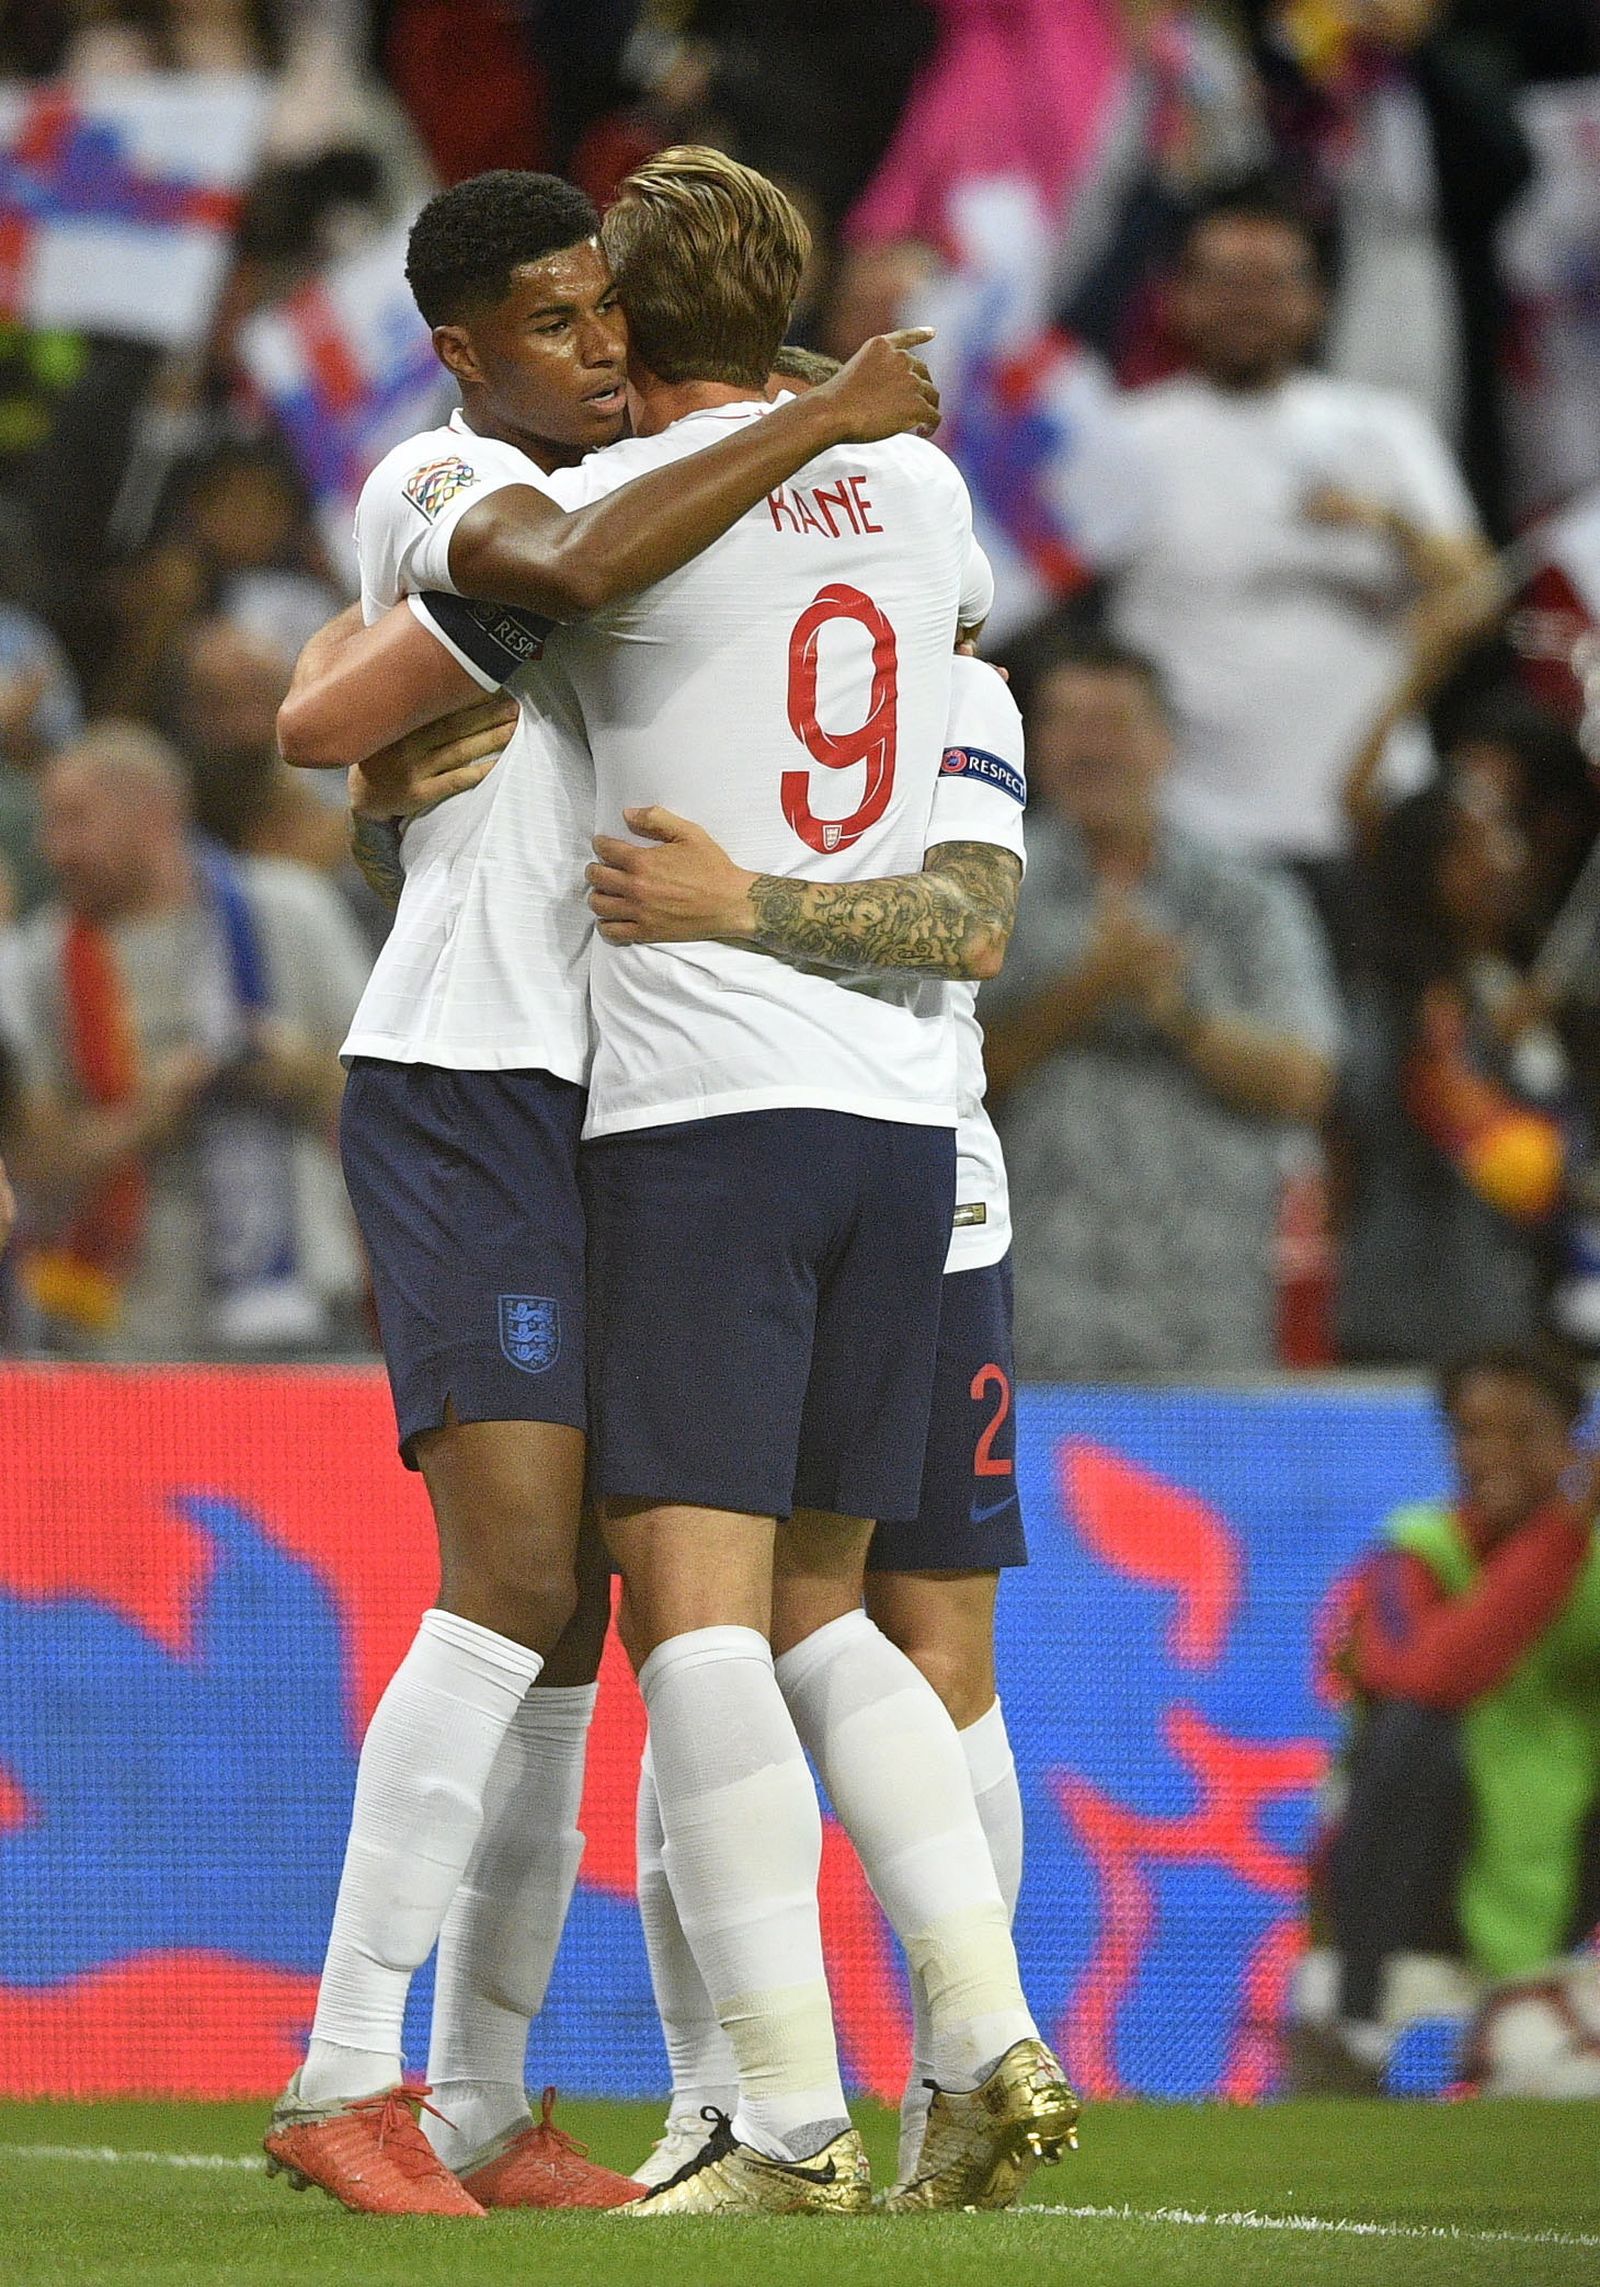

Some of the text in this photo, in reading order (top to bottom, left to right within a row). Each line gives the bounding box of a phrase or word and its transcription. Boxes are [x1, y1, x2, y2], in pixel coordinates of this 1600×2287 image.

[766, 475, 884, 539] KANE
[494, 619, 537, 658] RESP
[780, 582, 898, 855] 9
[968, 756, 1025, 798] RESPECT
[970, 1362, 1012, 1477] 2
